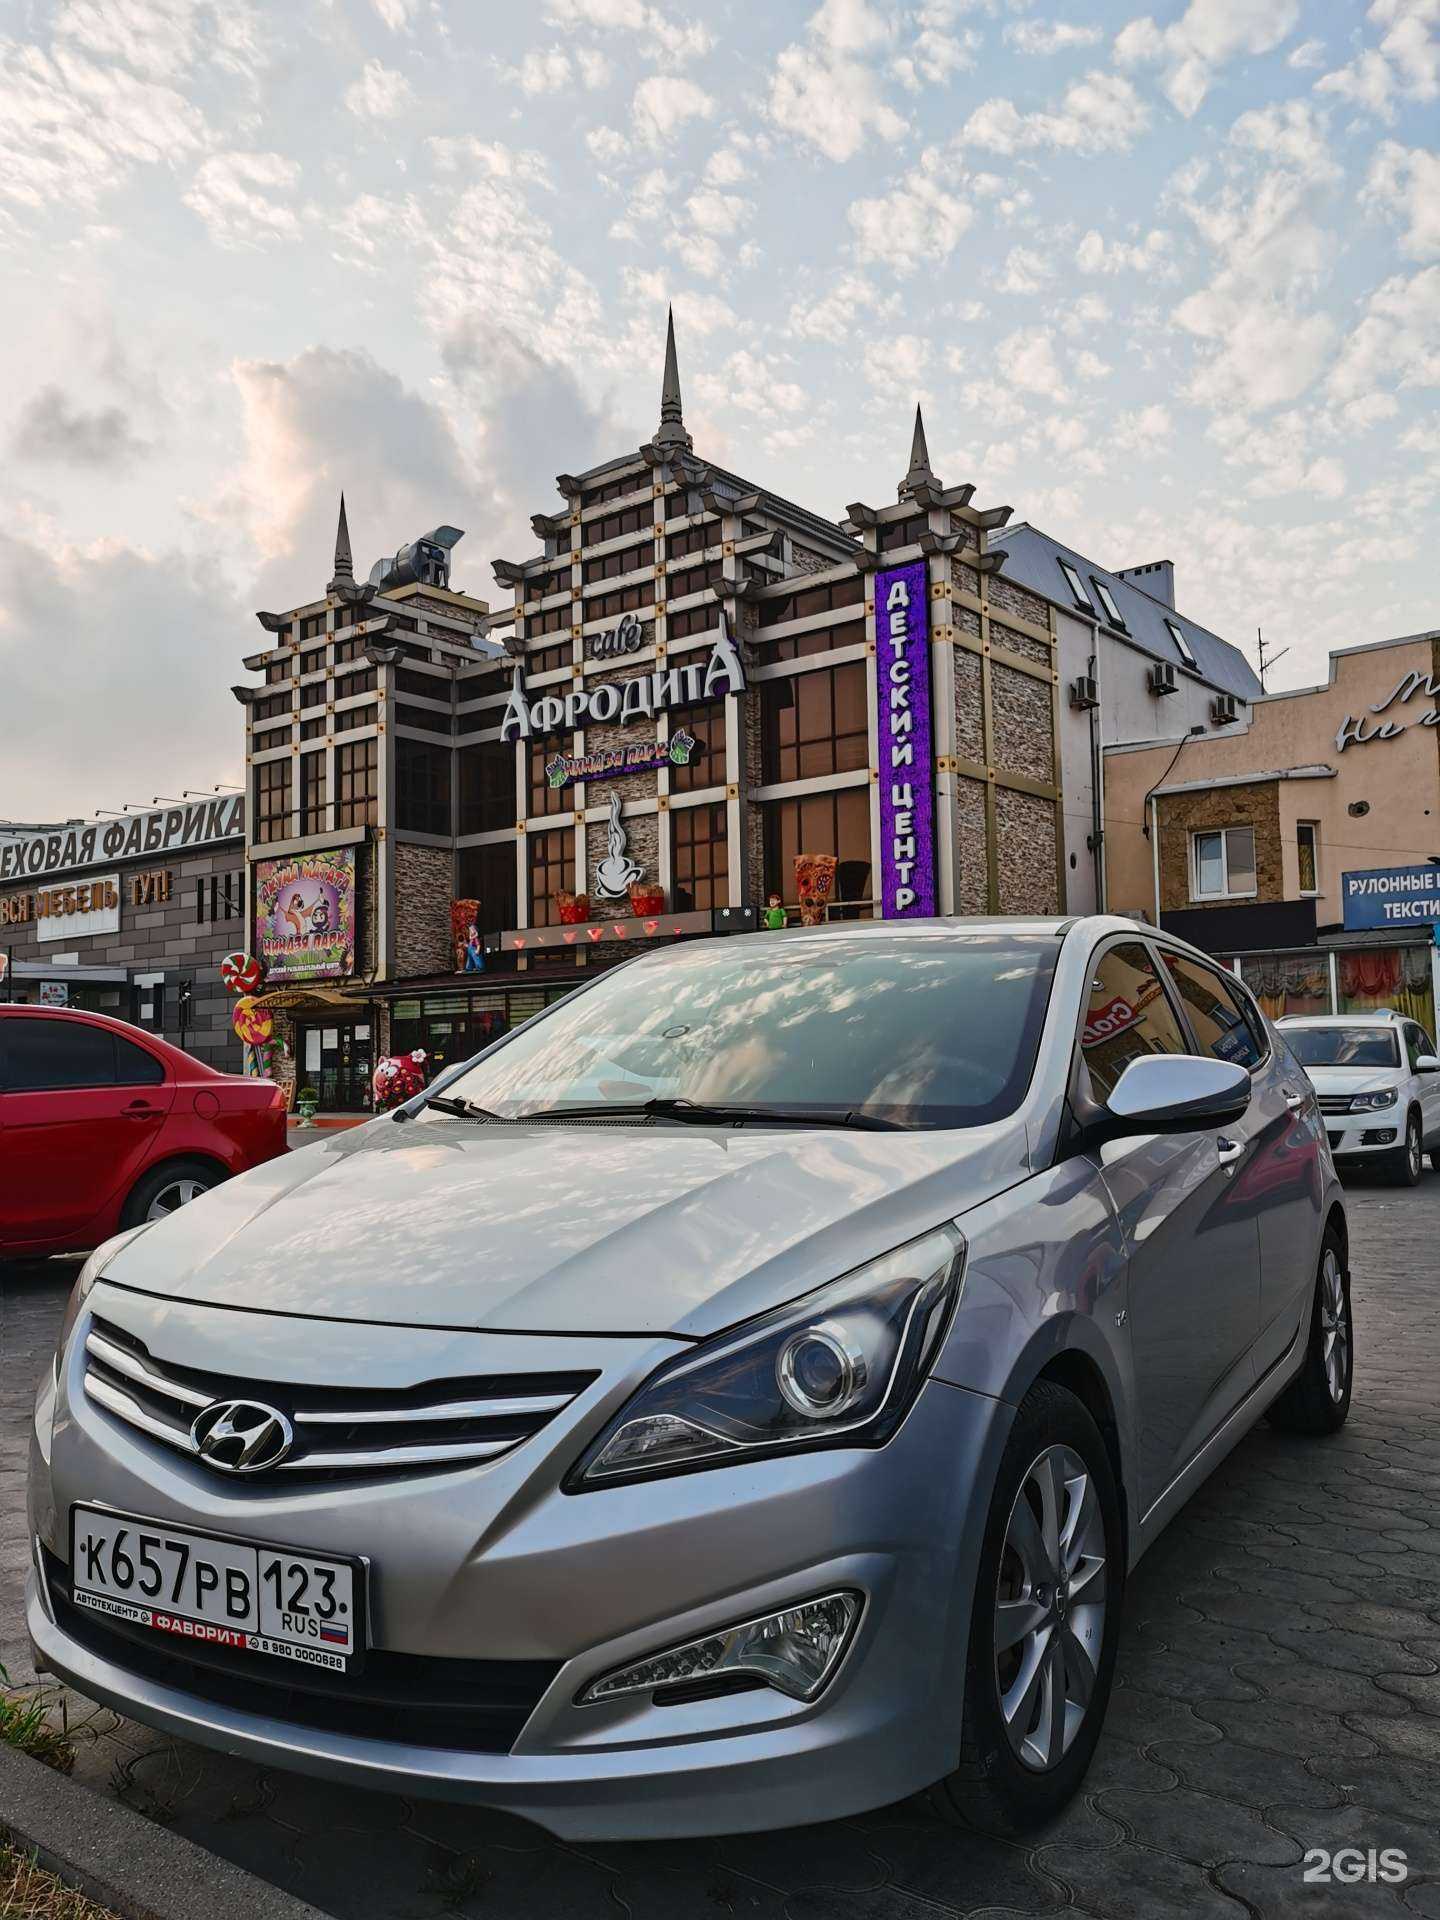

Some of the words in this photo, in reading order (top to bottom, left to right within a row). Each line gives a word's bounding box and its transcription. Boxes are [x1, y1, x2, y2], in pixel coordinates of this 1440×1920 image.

[589, 614, 642, 661] cafe
[886, 580, 913, 768] ДЕТСКИЙ
[626, 741, 670, 766] ПАРК
[103, 796, 245, 859] ФАБРИКА
[891, 782, 916, 911] ЦЕНТР
[0, 893, 32, 925] ВСЯ
[34, 880, 119, 920] МЕБЕЛЬ
[128, 870, 174, 906] ТУТ!
[1349, 872, 1433, 896] РУЛОННЫЕ
[1383, 900, 1440, 919] ТЕКСТИ
[263, 933, 310, 956] НИНДЗЯ
[313, 929, 348, 952] ПАРК
[263, 1558, 337, 1620] 123
[76, 1592, 139, 1620] АВТОТЕХЦЕНТР
[156, 1614, 242, 1647] ФАВОРИТ
[262, 1640, 269, 1651] 8
[271, 1642, 292, 1656] 980
[281, 1612, 319, 1638] RUS
